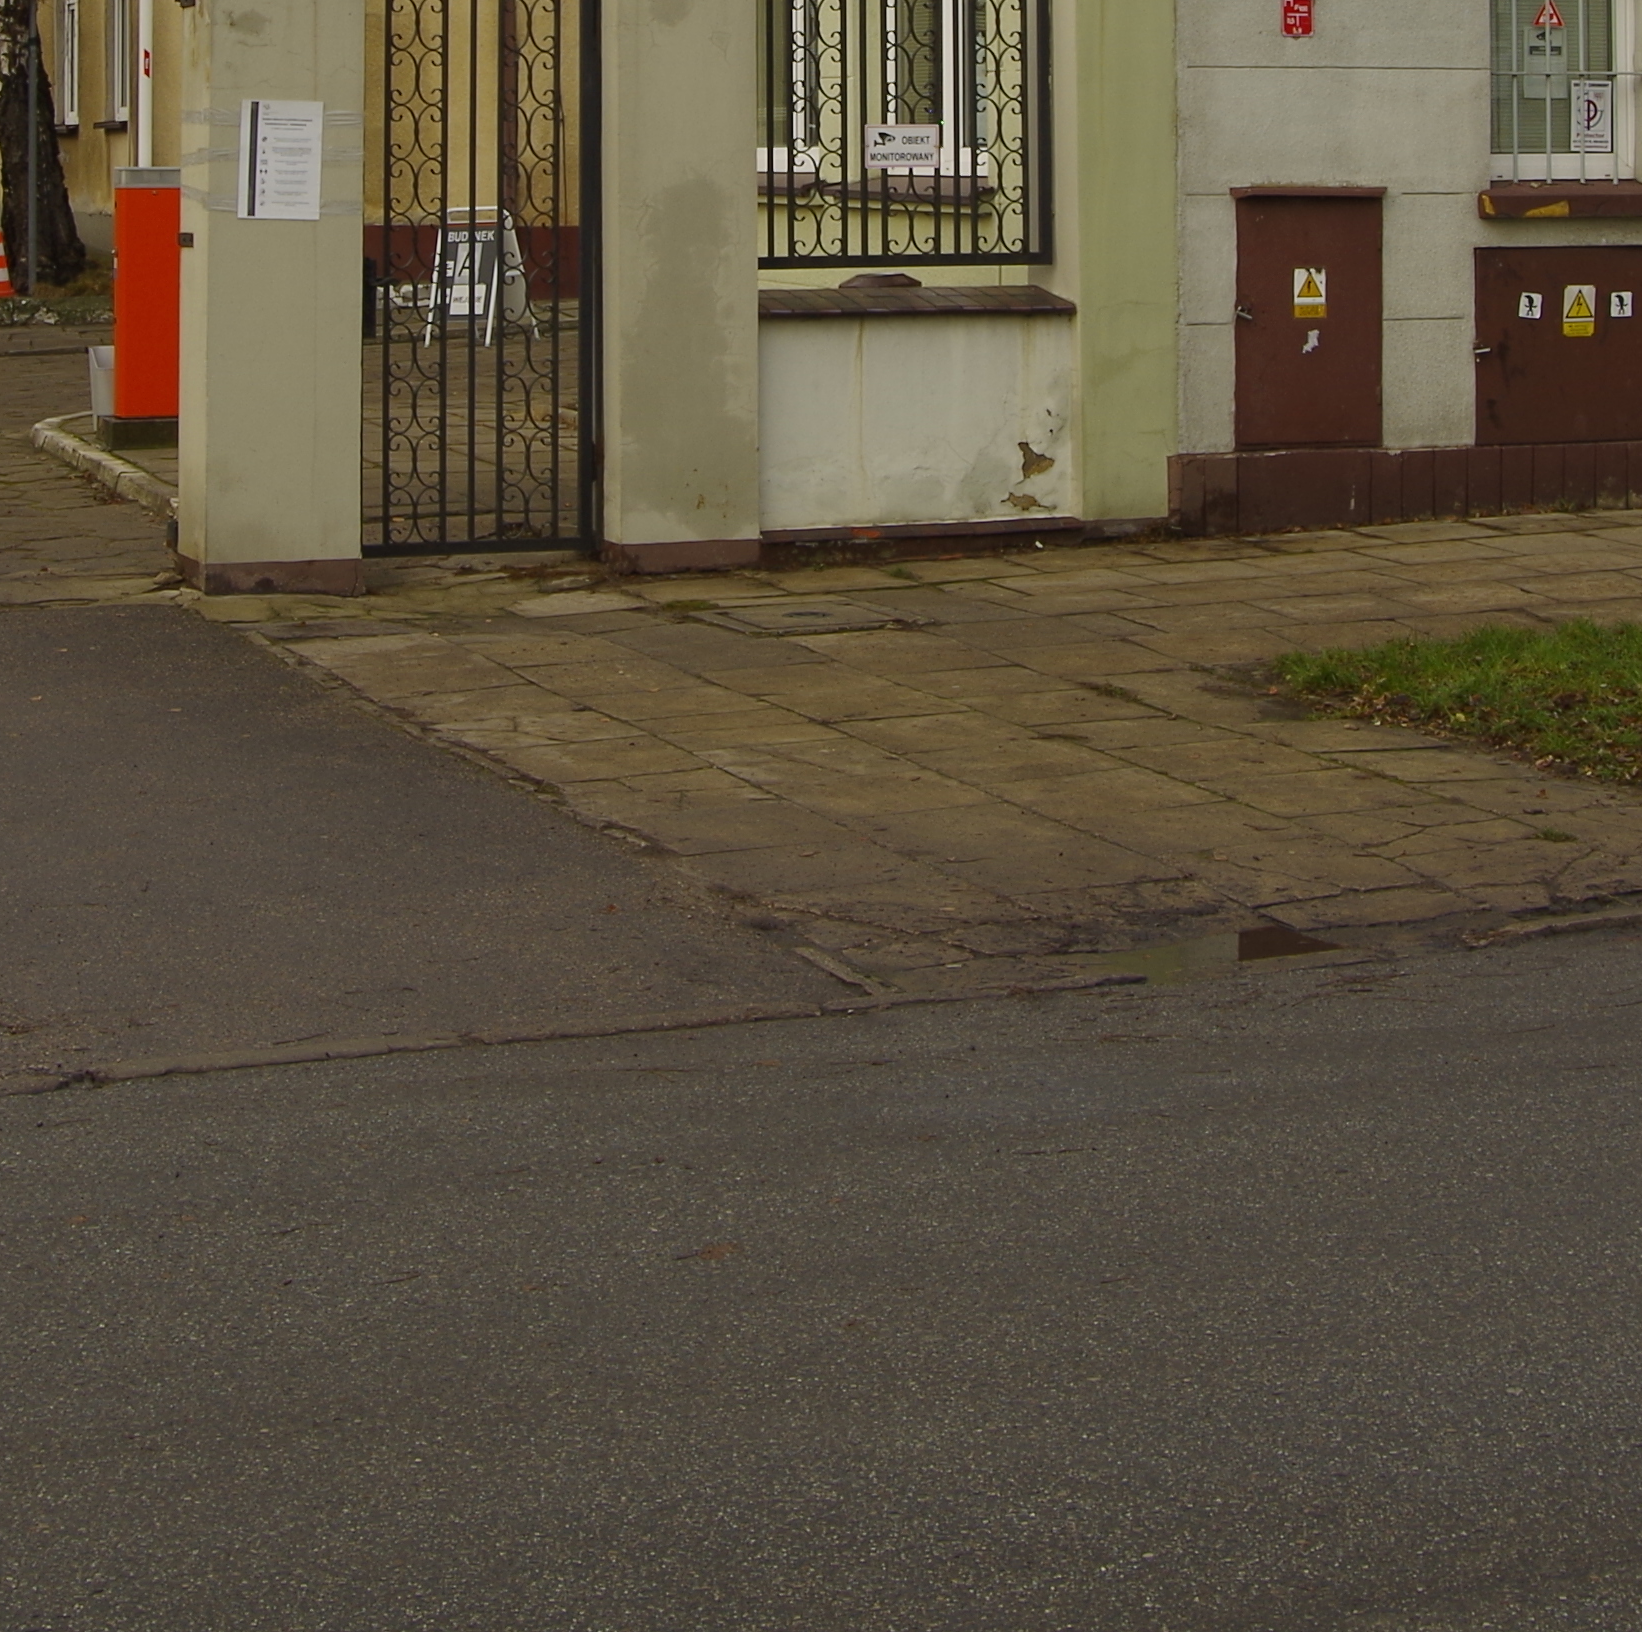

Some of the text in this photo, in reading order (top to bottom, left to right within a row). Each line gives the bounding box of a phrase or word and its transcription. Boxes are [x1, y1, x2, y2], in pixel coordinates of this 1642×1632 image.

[901, 135, 930, 145] OBIEKT
[870, 152, 934, 161] MONITOROWANY
[447, 230, 495, 243] BUDNEK
